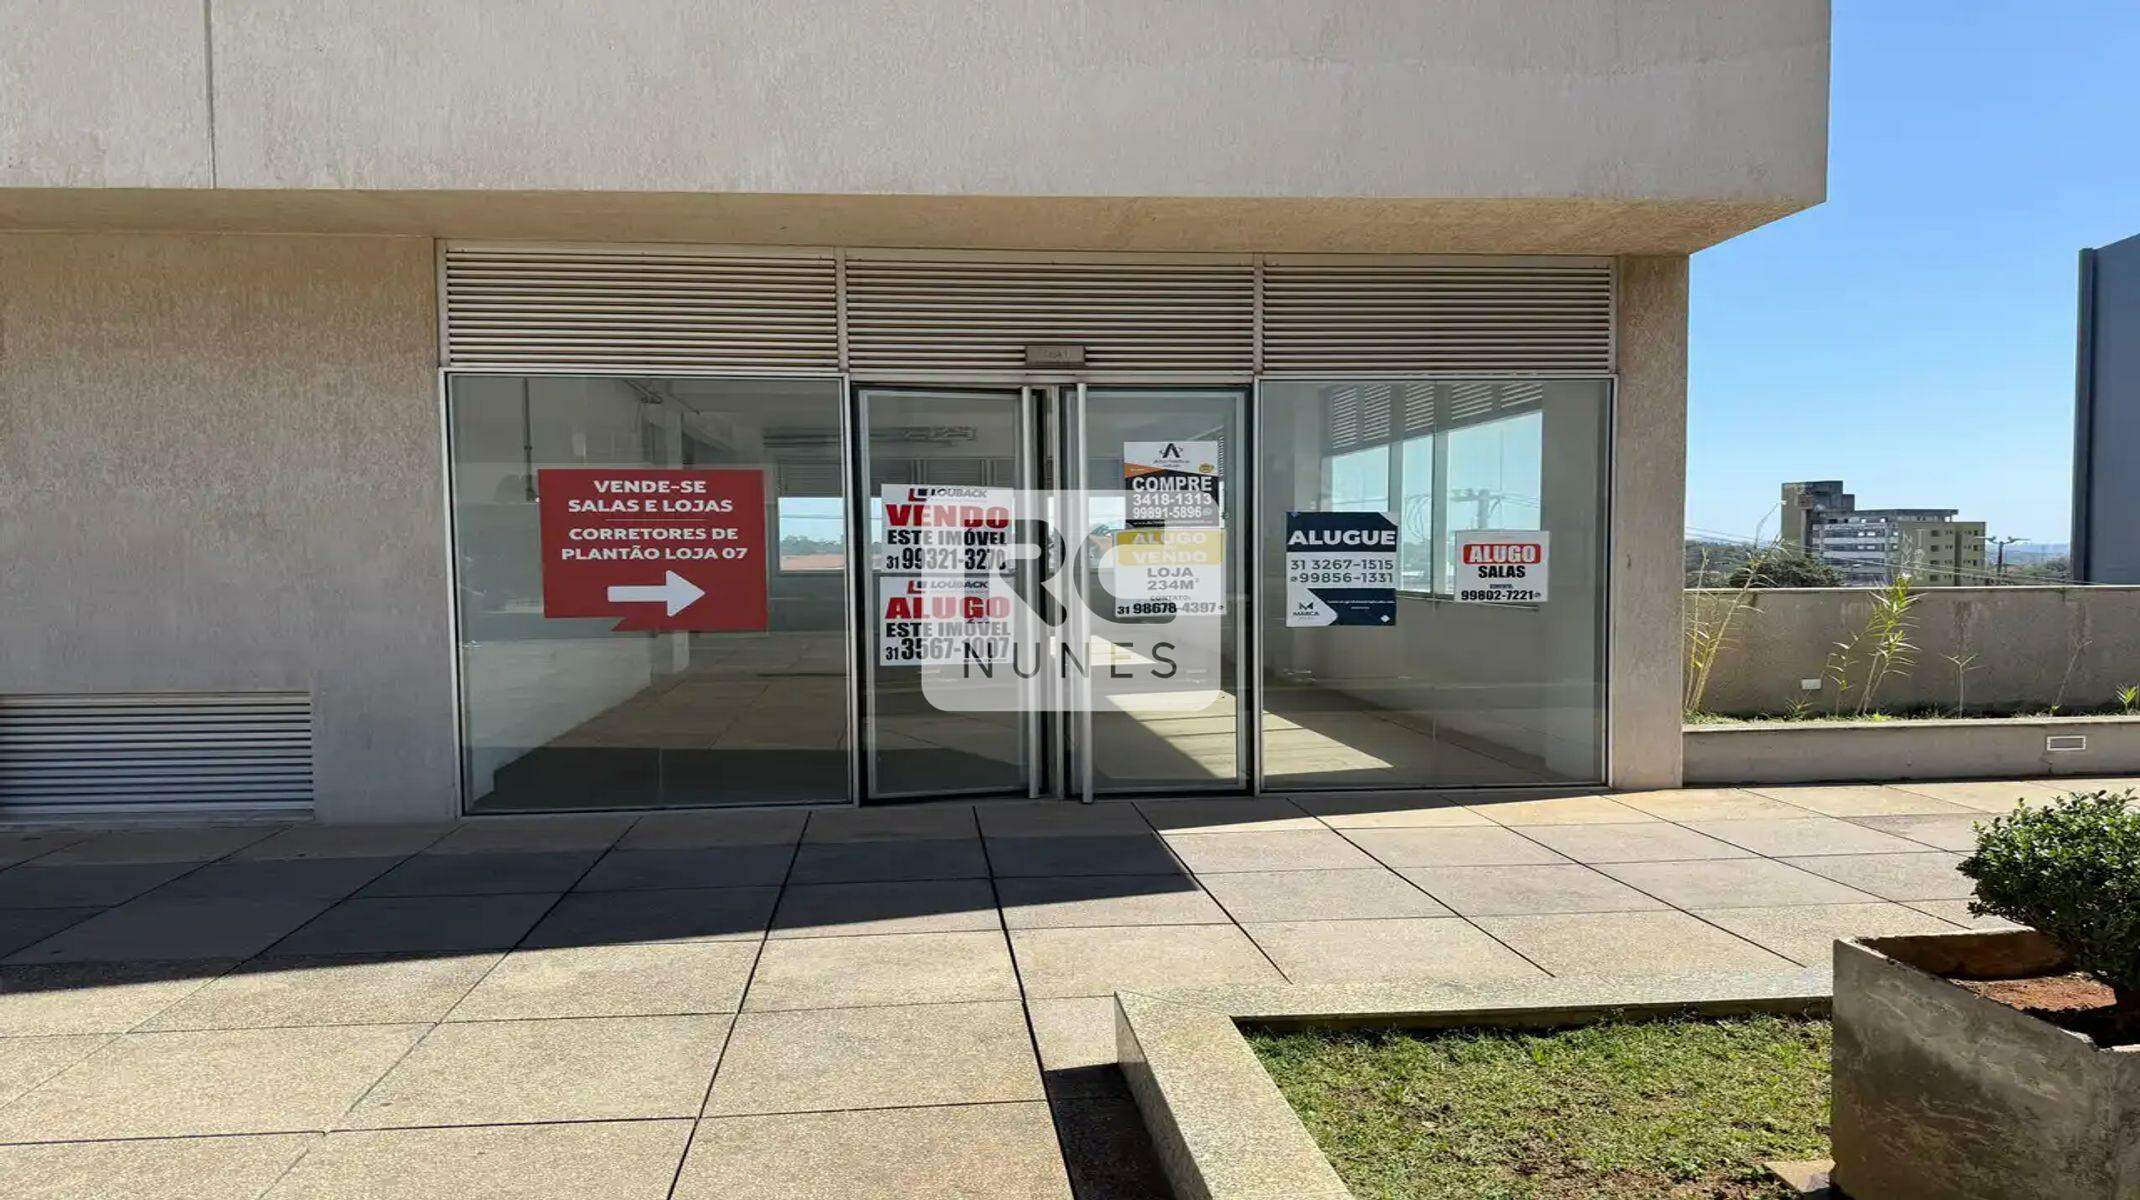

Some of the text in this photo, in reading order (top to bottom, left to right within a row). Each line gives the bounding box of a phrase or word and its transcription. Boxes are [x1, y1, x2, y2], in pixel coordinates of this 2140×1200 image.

[593, 480, 707, 494] VENDE-SE
[1132, 476, 1212, 492] COMPRE
[568, 499, 733, 513] SALAS E LOJAS
[1132, 493, 1212, 506] 3418-1313
[885, 504, 1010, 529] VENDO
[568, 528, 738, 540] CORRETORES DE
[887, 528, 1007, 546] ESTE IMÓVEL
[1133, 531, 1207, 545] ALUGO
[1288, 530, 1396, 546] ALUGUE
[561, 545, 748, 561] PLANTÃO LOJA 07
[1133, 549, 1208, 563] VENDO
[1469, 545, 1536, 563] ALUGO
[886, 555, 899, 570] 31
[1290, 559, 1394, 570] 31 3267-1515
[1147, 567, 1194, 578] LOJA
[1299, 572, 1393, 583] 99856-1331
[1478, 565, 1526, 578] SALAS
[885, 596, 1011, 619] ALUGO
[1117, 606, 1130, 614] 31
[886, 619, 1011, 638] ESTE IMÓVEL
[885, 646, 899, 660] 31
